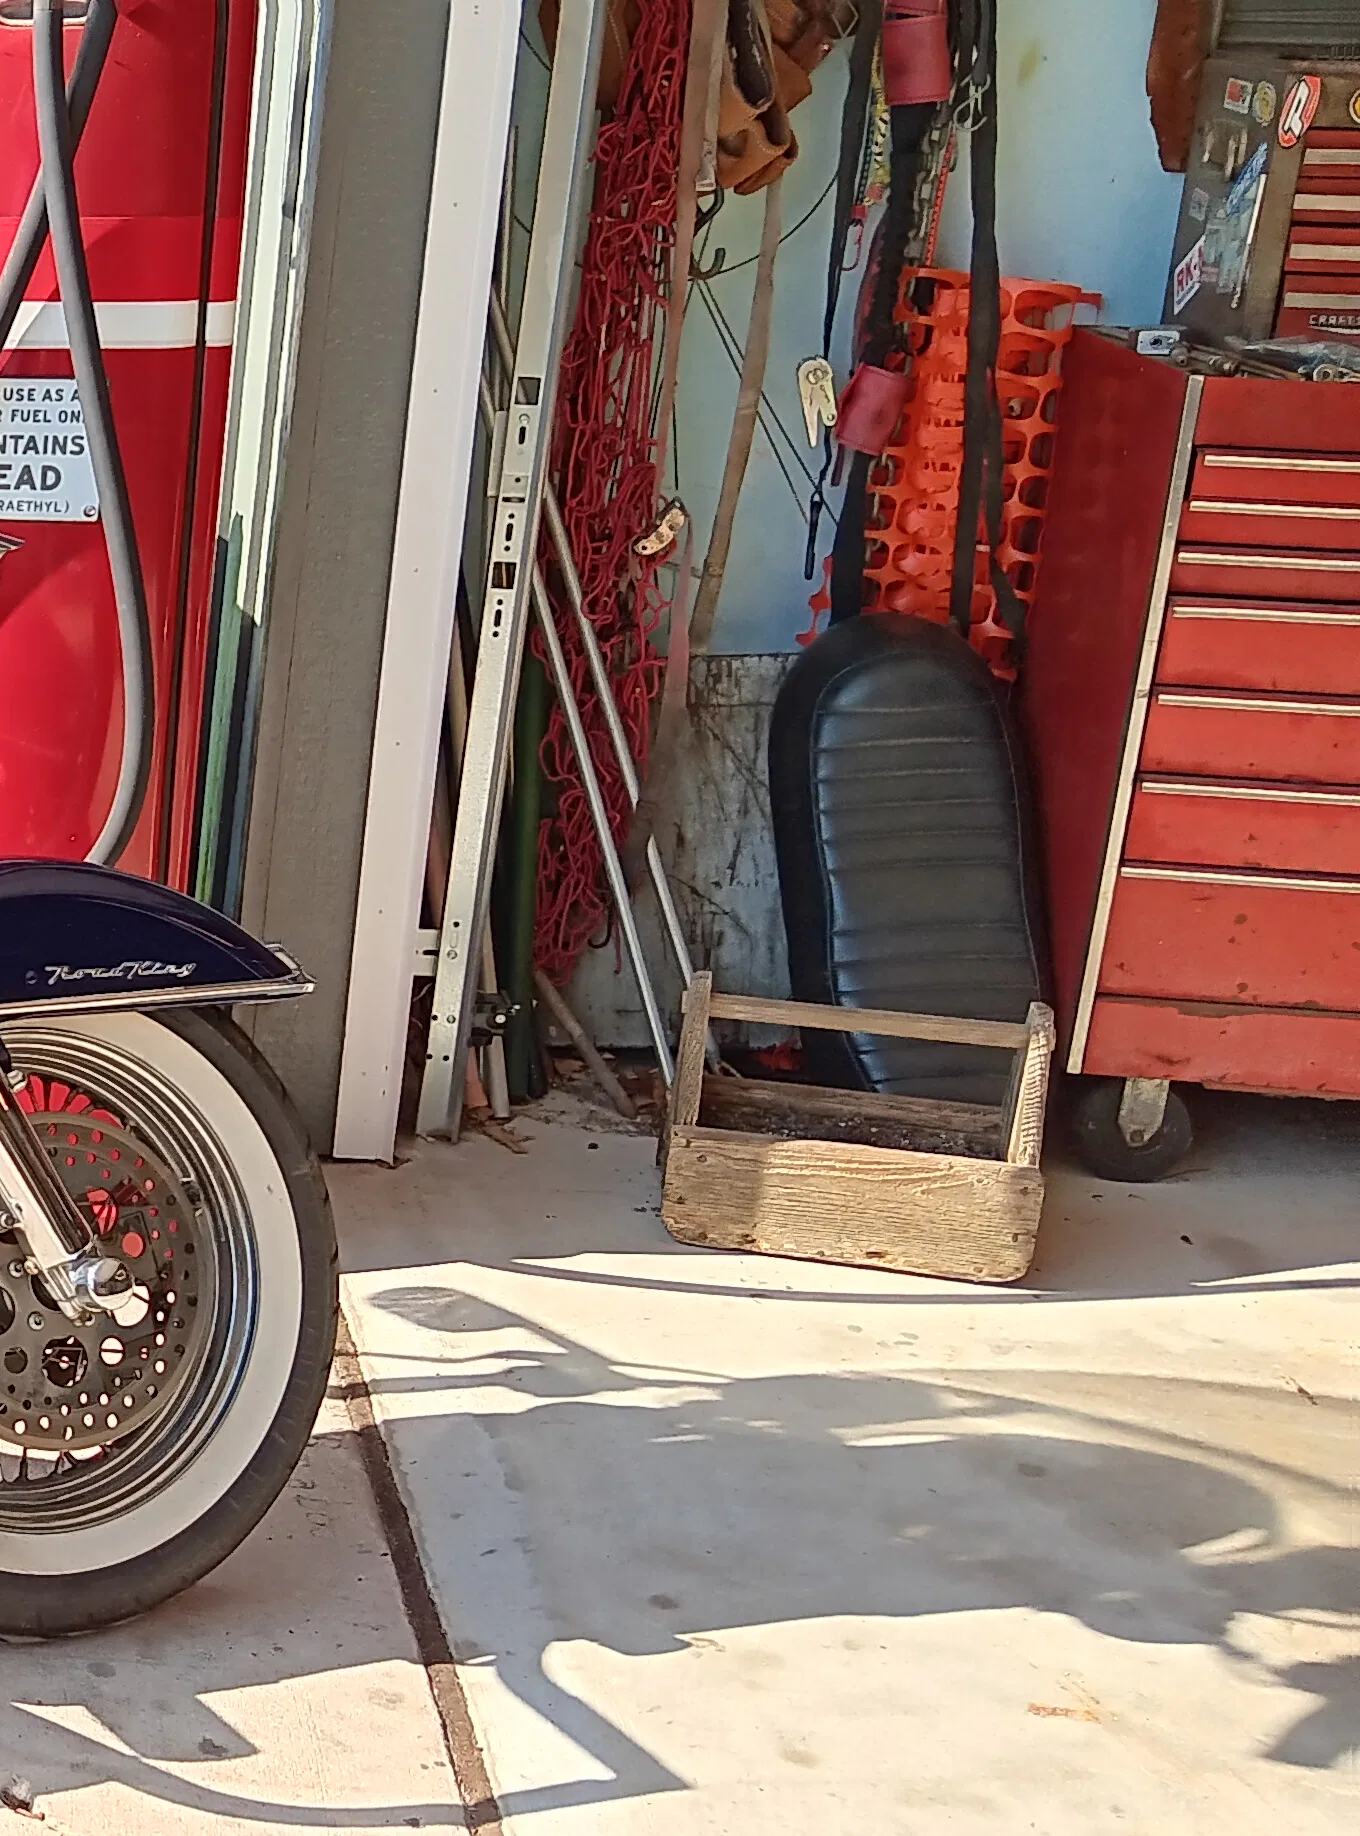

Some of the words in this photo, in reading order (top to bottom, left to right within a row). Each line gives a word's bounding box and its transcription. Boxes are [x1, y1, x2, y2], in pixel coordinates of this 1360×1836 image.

[3, 388, 36, 402] USE
[42, 388, 64, 402] AS
[11, 409, 51, 423] FUEL
[58, 410, 83, 423] ON
